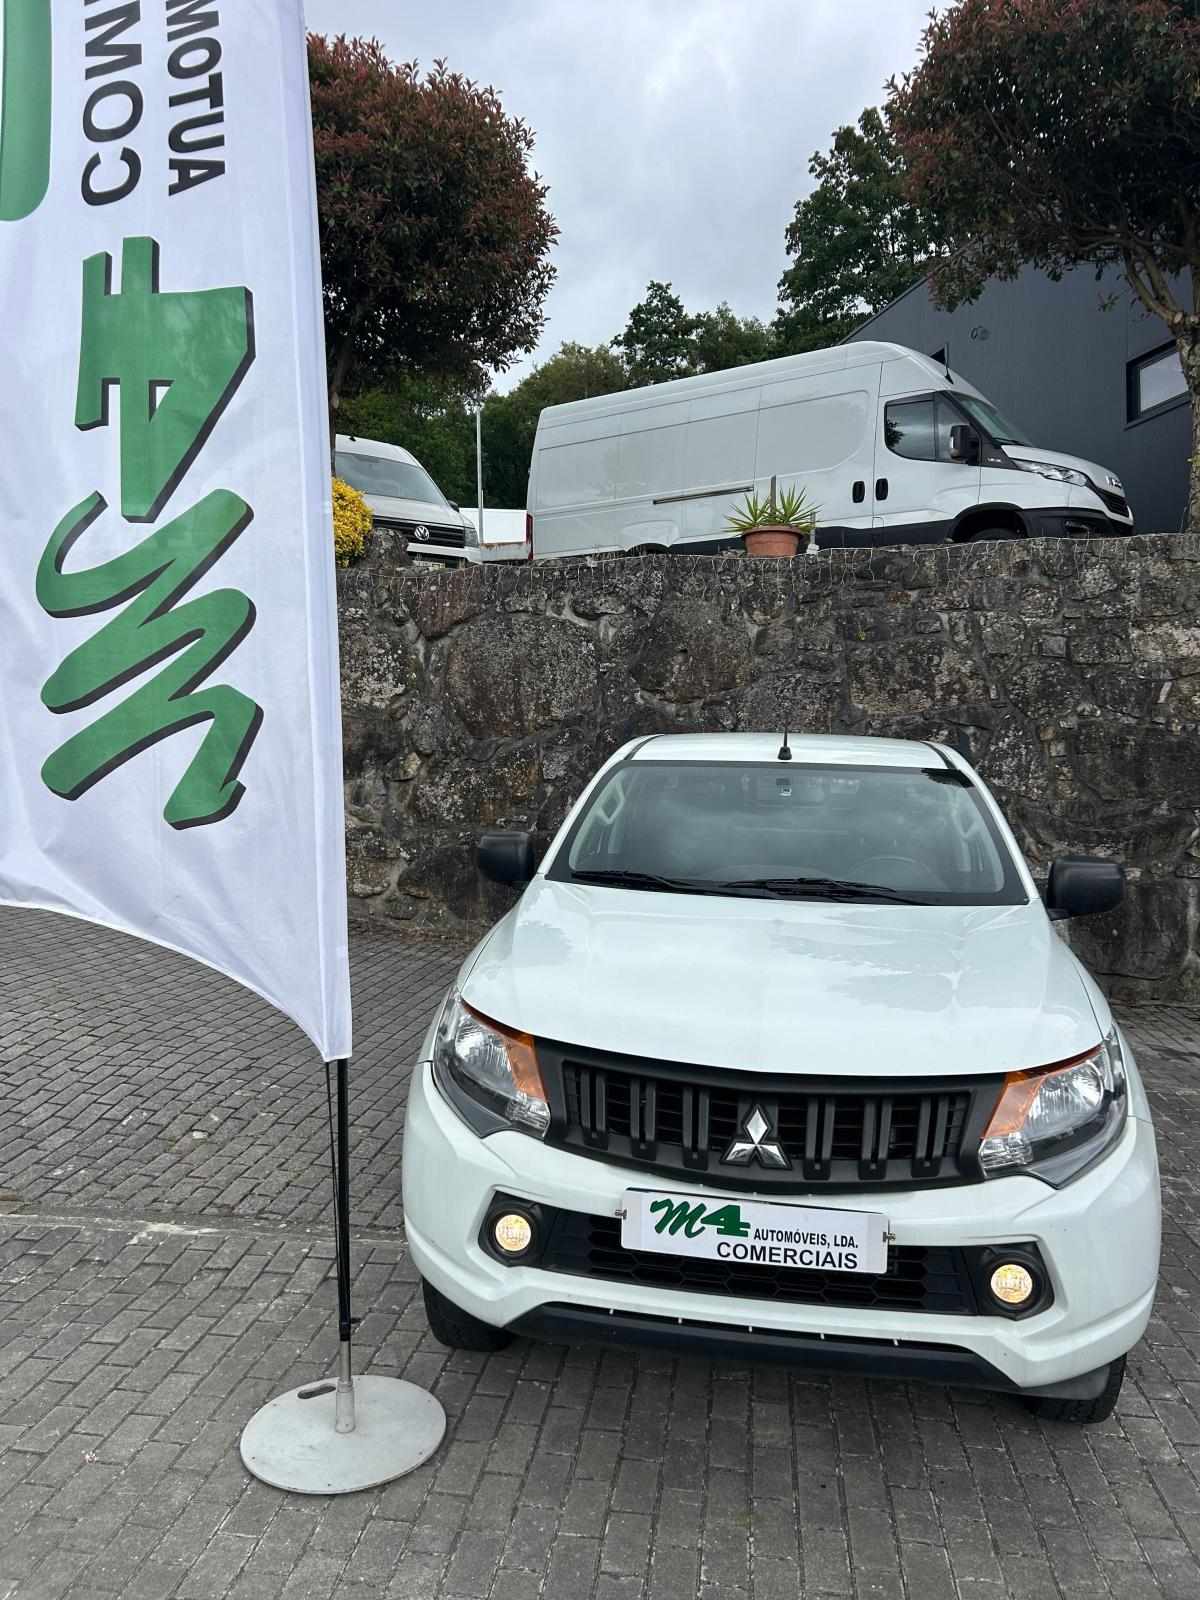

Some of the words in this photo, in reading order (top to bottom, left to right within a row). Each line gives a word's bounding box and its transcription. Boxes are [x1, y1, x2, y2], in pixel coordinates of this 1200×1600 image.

[753, 1227, 831, 1249] AUTOMÓVEIS,
[833, 1234, 859, 1249] LDA.
[716, 1241, 858, 1270] COMERCIAIS
